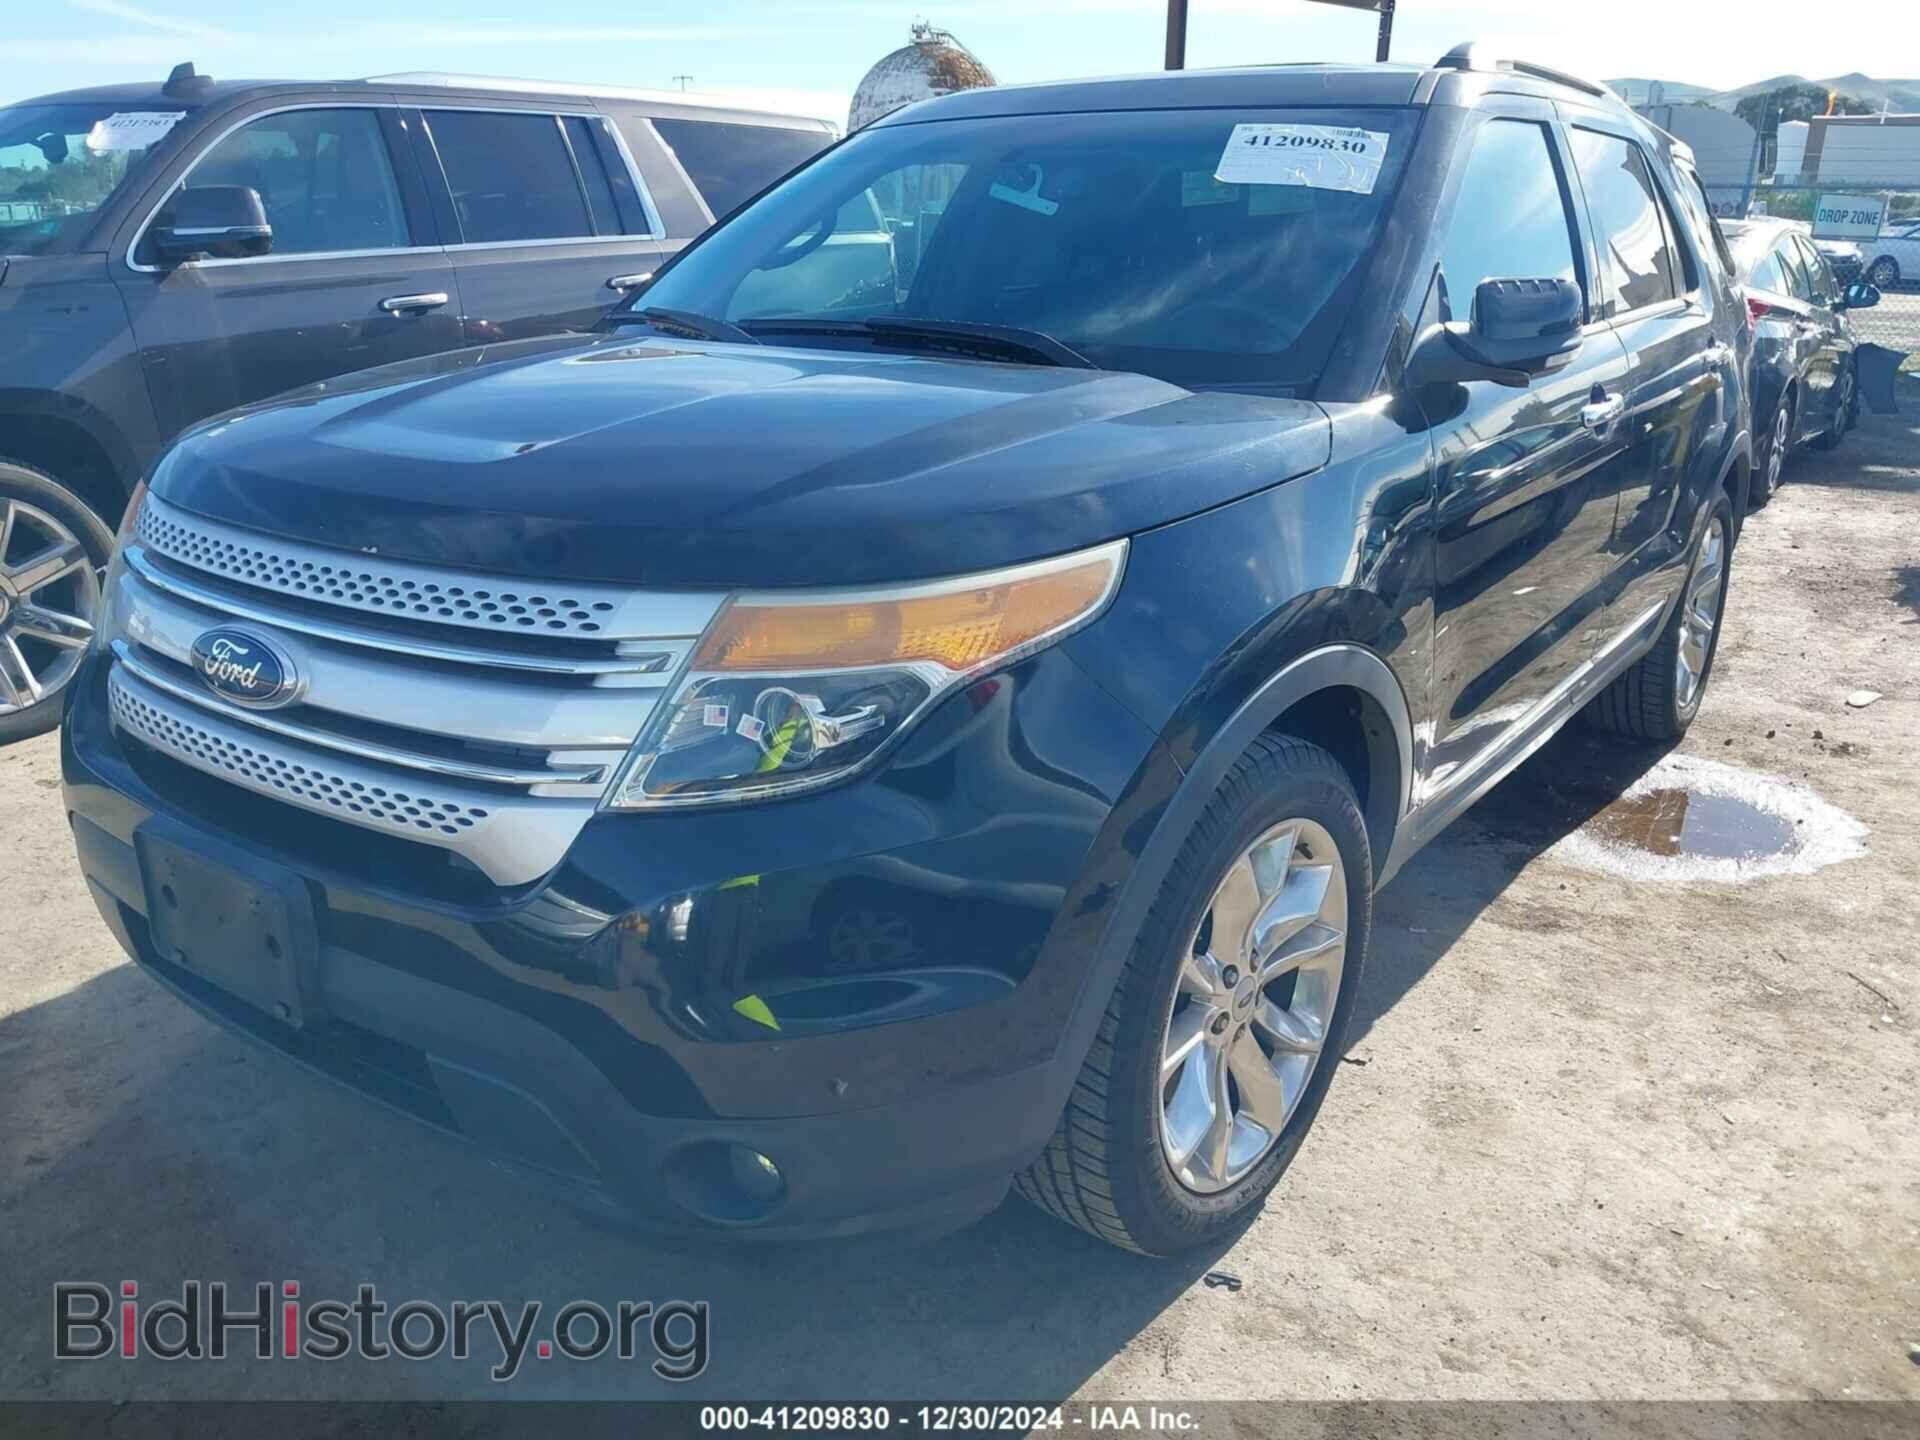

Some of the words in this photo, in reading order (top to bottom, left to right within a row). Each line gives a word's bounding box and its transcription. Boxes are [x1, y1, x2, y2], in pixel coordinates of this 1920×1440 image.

[1243, 135, 1366, 154] 41209830
[1818, 208, 1848, 224] DROP
[1850, 210, 1879, 226] ZONE
[204, 638, 262, 688] Ford
